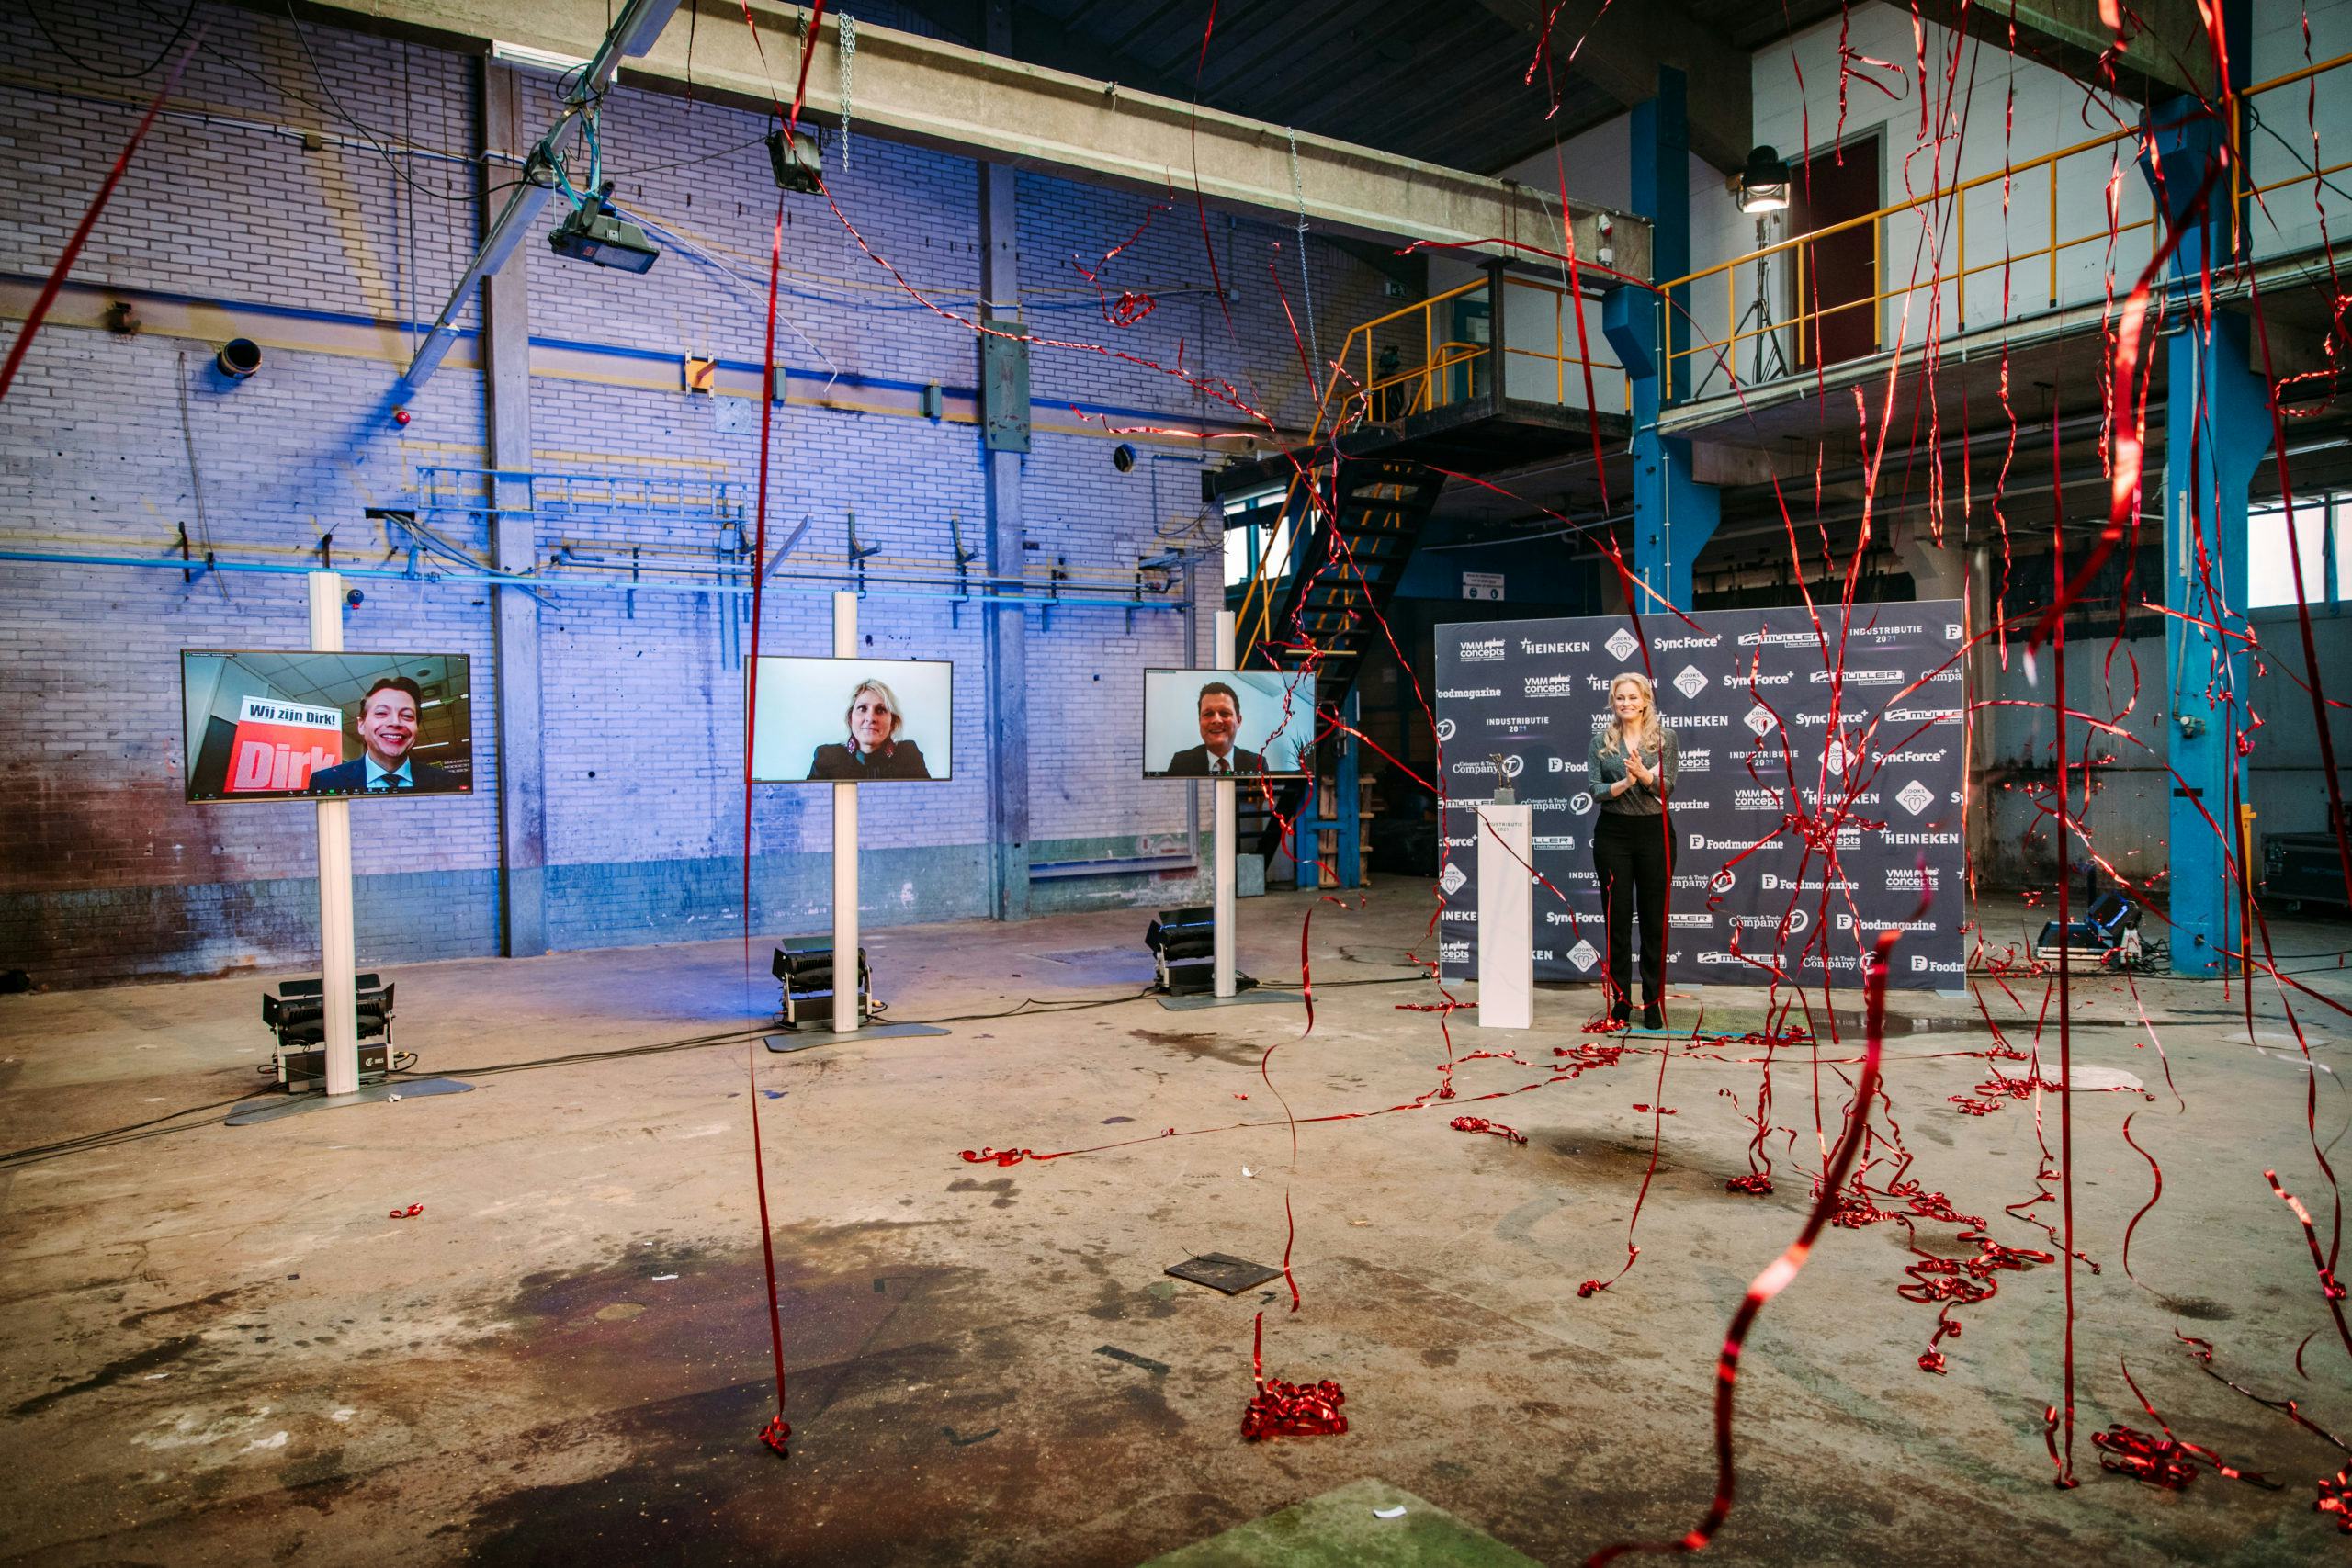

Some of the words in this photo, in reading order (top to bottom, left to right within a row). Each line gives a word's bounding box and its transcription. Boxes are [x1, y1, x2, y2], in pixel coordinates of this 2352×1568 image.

[1849, 626, 1922, 636] INDUSTRIBUTIE
[1460, 642, 1484, 650] VMM
[1526, 642, 1590, 654] HEINEKEN
[1460, 648, 1505, 658] concepts
[1525, 677, 1548, 686] VMM
[1524, 683, 1571, 694] concepts
[250, 704, 276, 719] Wij
[278, 707, 303, 723] zijn
[306, 710, 336, 726] Dirk!
[1486, 717, 1549, 725] INDUSTRIBUTIE
[1662, 716, 1728, 728] HEINEKEN
[233, 741, 335, 788] Dirk
[1453, 764, 1498, 774] Company
[1735, 790, 1760, 798] VMM
[1885, 834, 1959, 845] HEINEKEN
[1886, 869, 1913, 878] VMM
[1886, 877, 1938, 887] concepts
